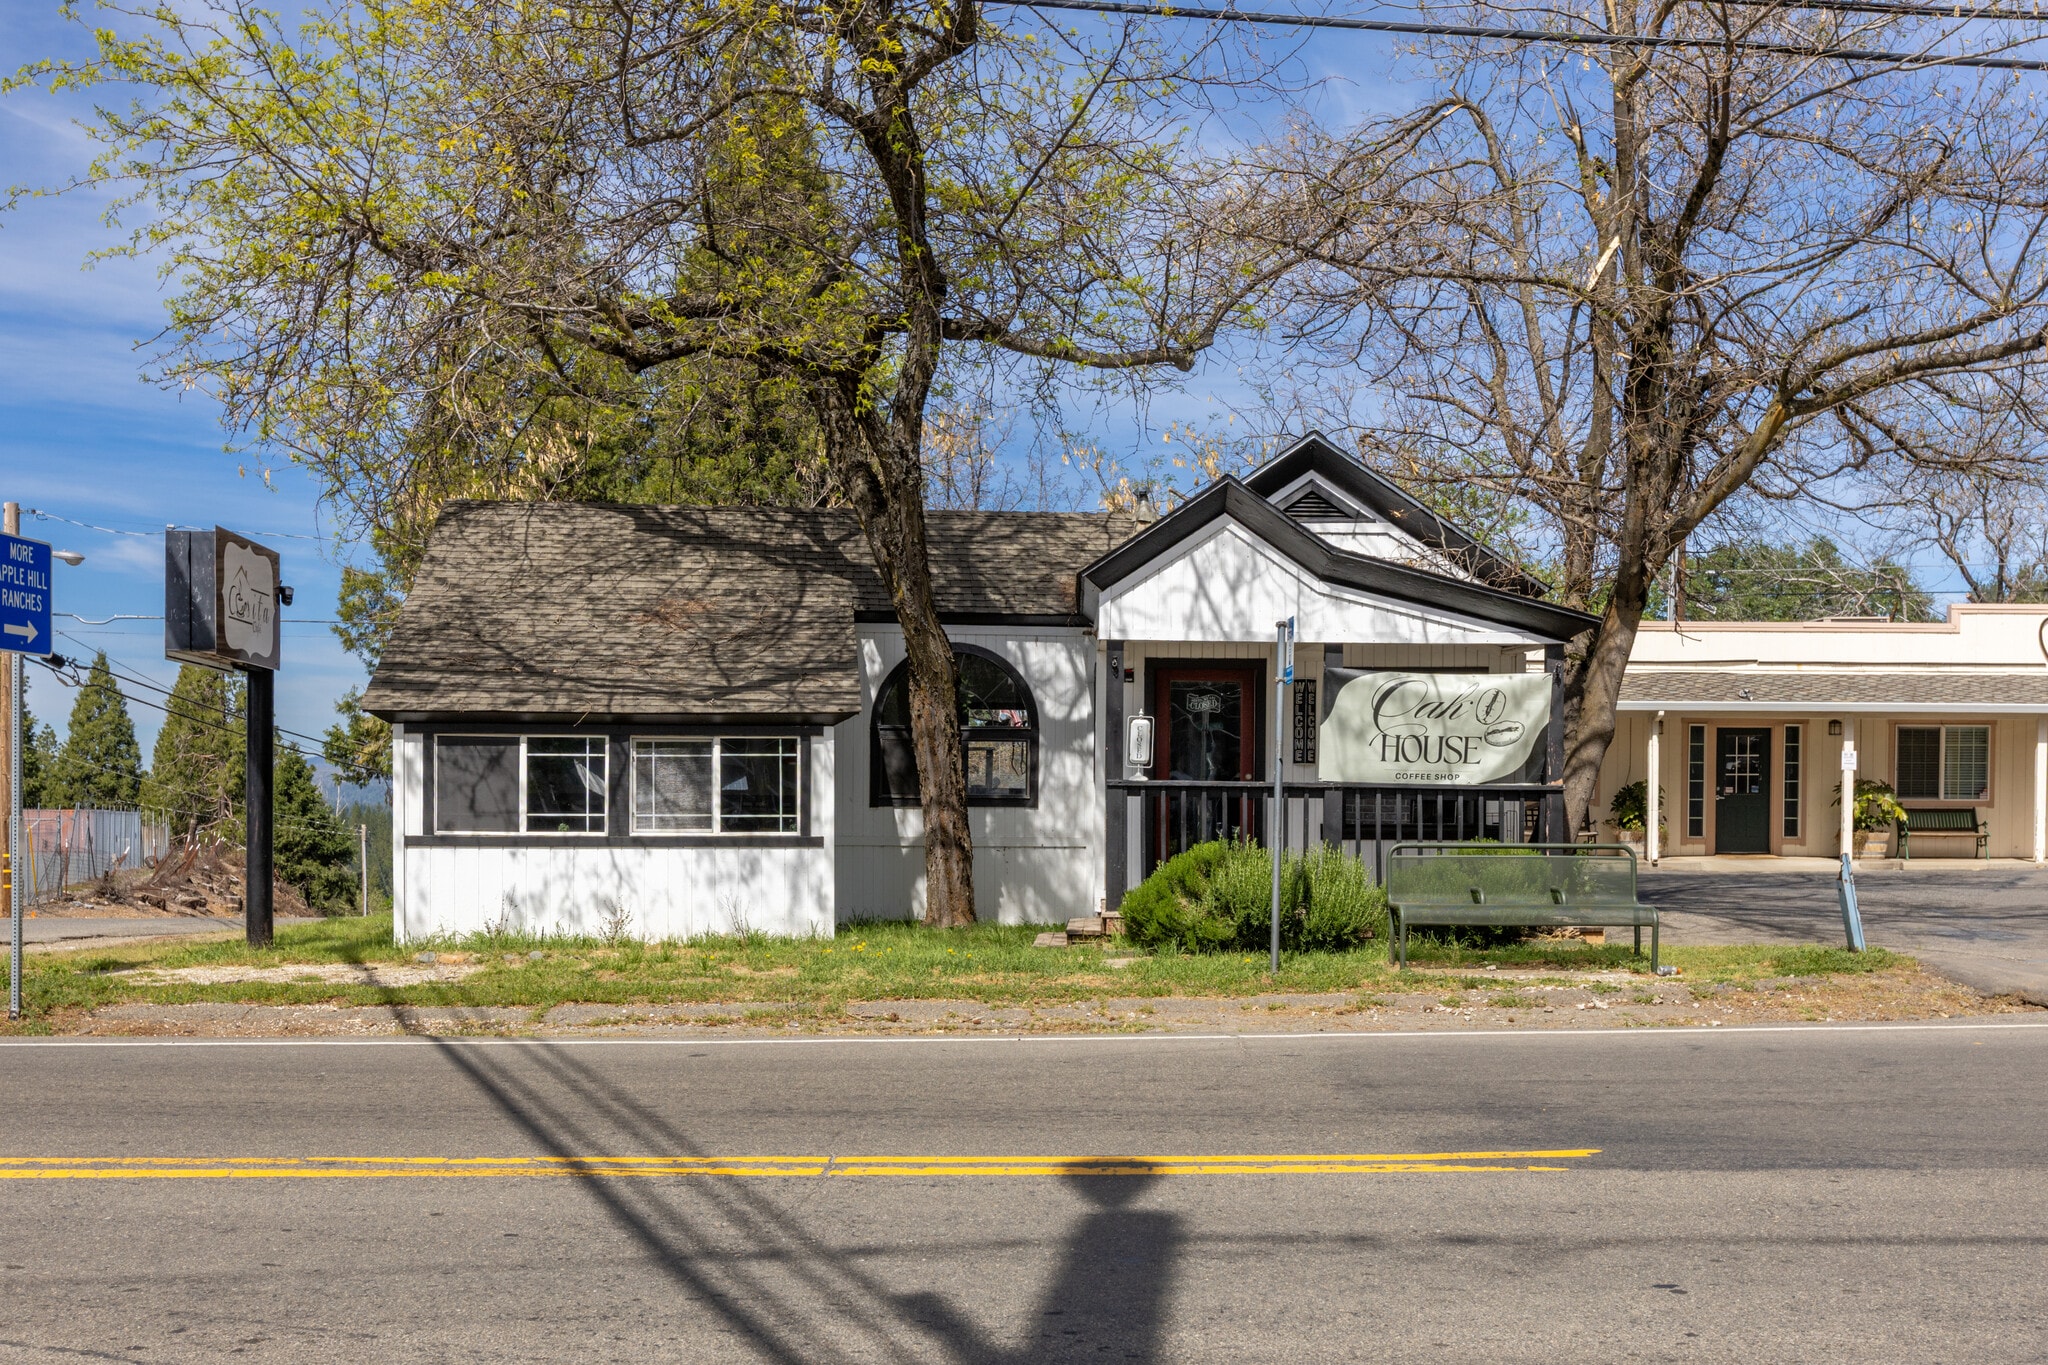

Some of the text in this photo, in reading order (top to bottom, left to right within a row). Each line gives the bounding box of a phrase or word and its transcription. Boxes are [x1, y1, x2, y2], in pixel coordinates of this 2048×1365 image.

[10, 542, 34, 564] MORE
[27, 569, 47, 590] HILL
[2, 588, 42, 612] RANCHES
[1295, 682, 1305, 761] WELCOME
[1307, 682, 1315, 761] WELCOME
[1369, 676, 1480, 746] Oak
[1380, 734, 1482, 765] HOUSE
[1395, 772, 1460, 781] COFFEE SHOP
